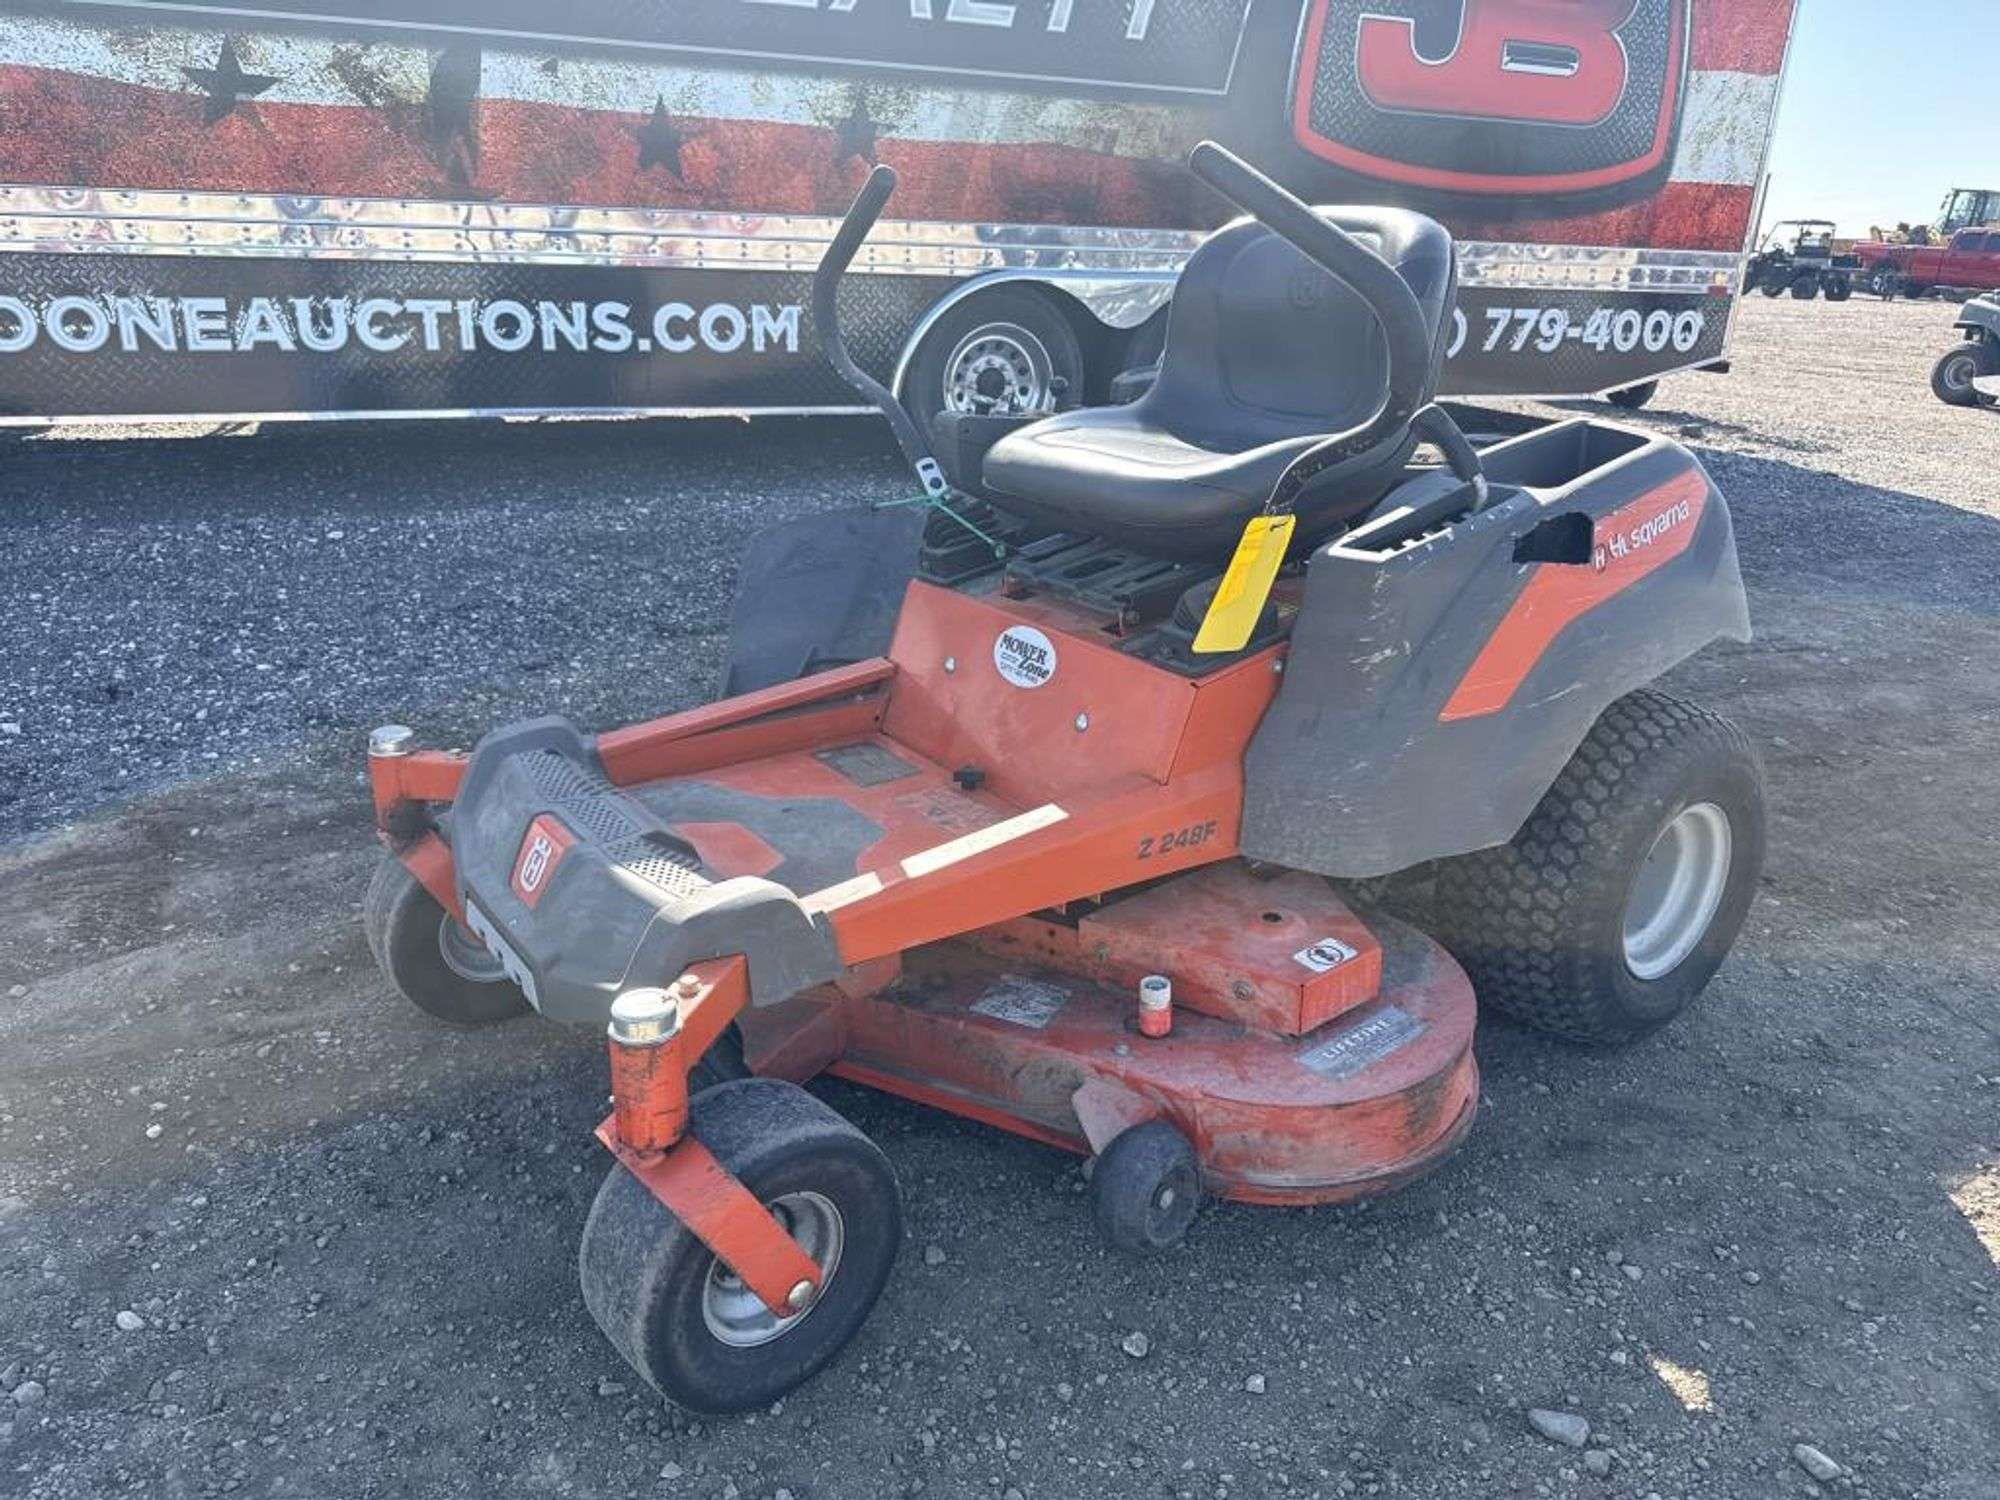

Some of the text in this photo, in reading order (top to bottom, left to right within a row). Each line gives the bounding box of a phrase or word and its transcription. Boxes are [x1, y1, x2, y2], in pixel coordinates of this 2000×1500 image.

[1482, 308, 1703, 352] 779-4000
[1000, 634, 1047, 666] MOWER
[1018, 655, 1050, 679] Zone
[1138, 837, 1154, 860] Z
